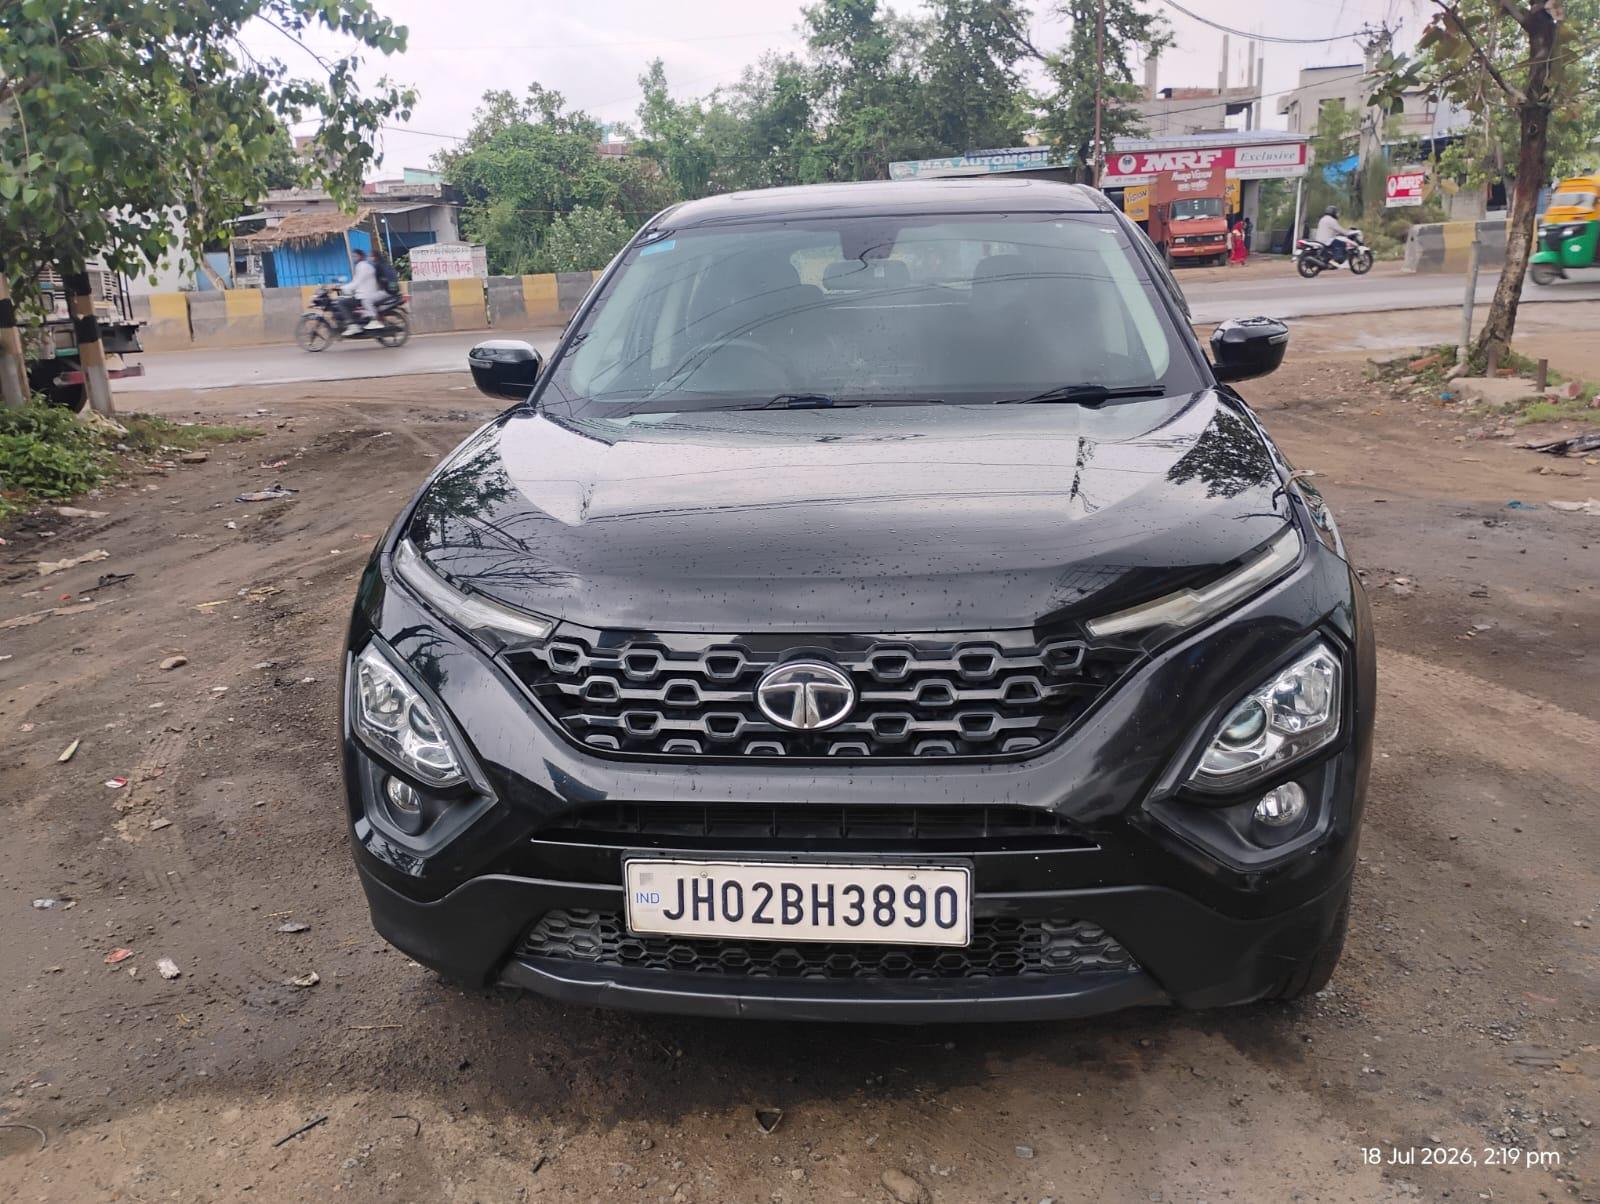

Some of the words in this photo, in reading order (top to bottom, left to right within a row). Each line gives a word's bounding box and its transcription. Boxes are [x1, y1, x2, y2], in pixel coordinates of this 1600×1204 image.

[917, 160, 953, 171] MAA
[1141, 150, 1222, 172] MRF
[1240, 150, 1296, 161] Exclusive
[635, 892, 660, 905] IND
[663, 877, 959, 930] JH02BH3890
